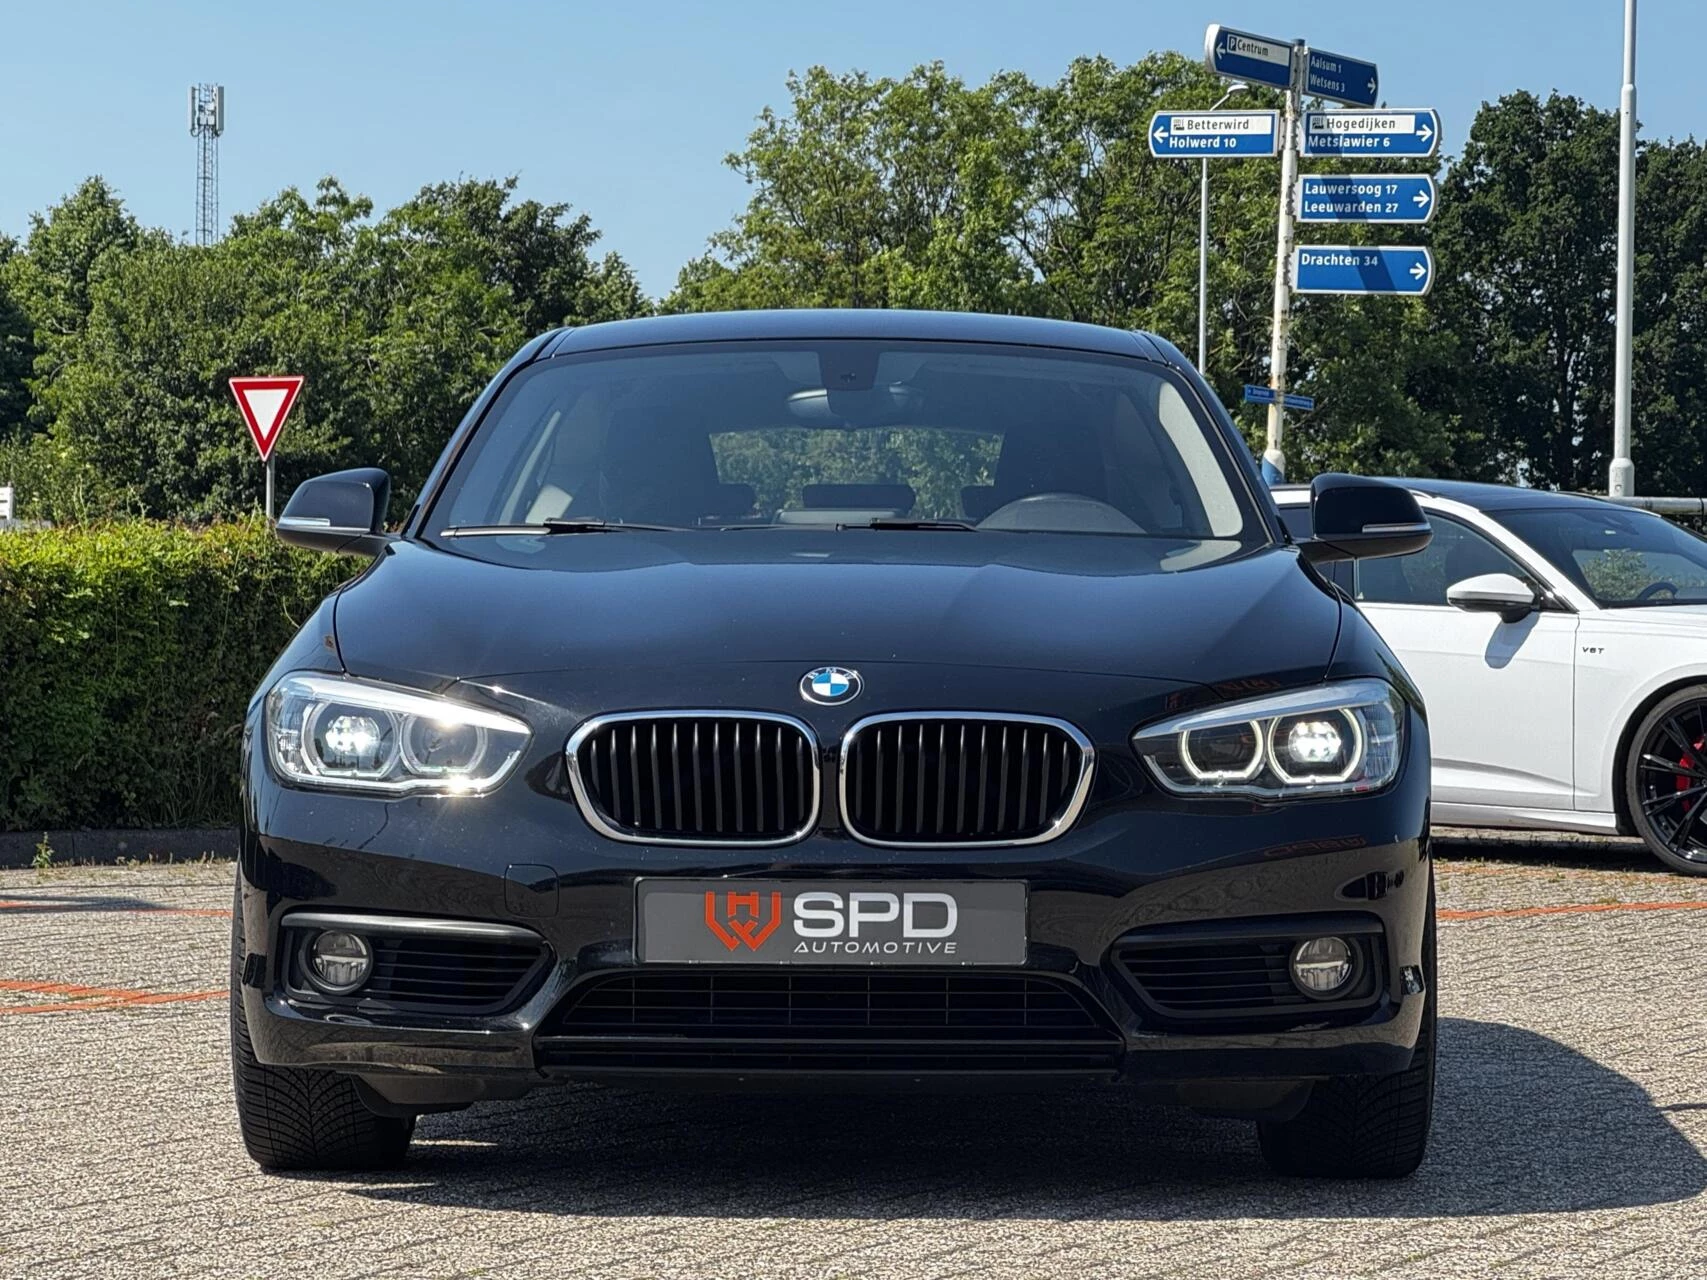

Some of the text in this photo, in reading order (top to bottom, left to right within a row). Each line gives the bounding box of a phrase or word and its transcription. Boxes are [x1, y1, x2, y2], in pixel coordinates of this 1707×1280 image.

[1237, 40, 1269, 56] Centrum
[1310, 55, 1342, 73] Aalsum 1
[1310, 75, 1345, 92] Wetsens 3
[1187, 118, 1249, 130] Betterwird
[1326, 118, 1396, 131] Hogedijken
[1169, 136, 1237, 148] Holwerd 10
[1308, 135, 1390, 147] Metslawier 6
[1305, 182, 1398, 197] Lauwersoog 17
[1304, 201, 1398, 213] Leeuwarden 27
[1301, 253, 1378, 266] Drachten 34
[807, 667, 857, 680] BMW
[793, 892, 958, 938] SPD
[794, 941, 958, 954] AUTOMOTIVE
